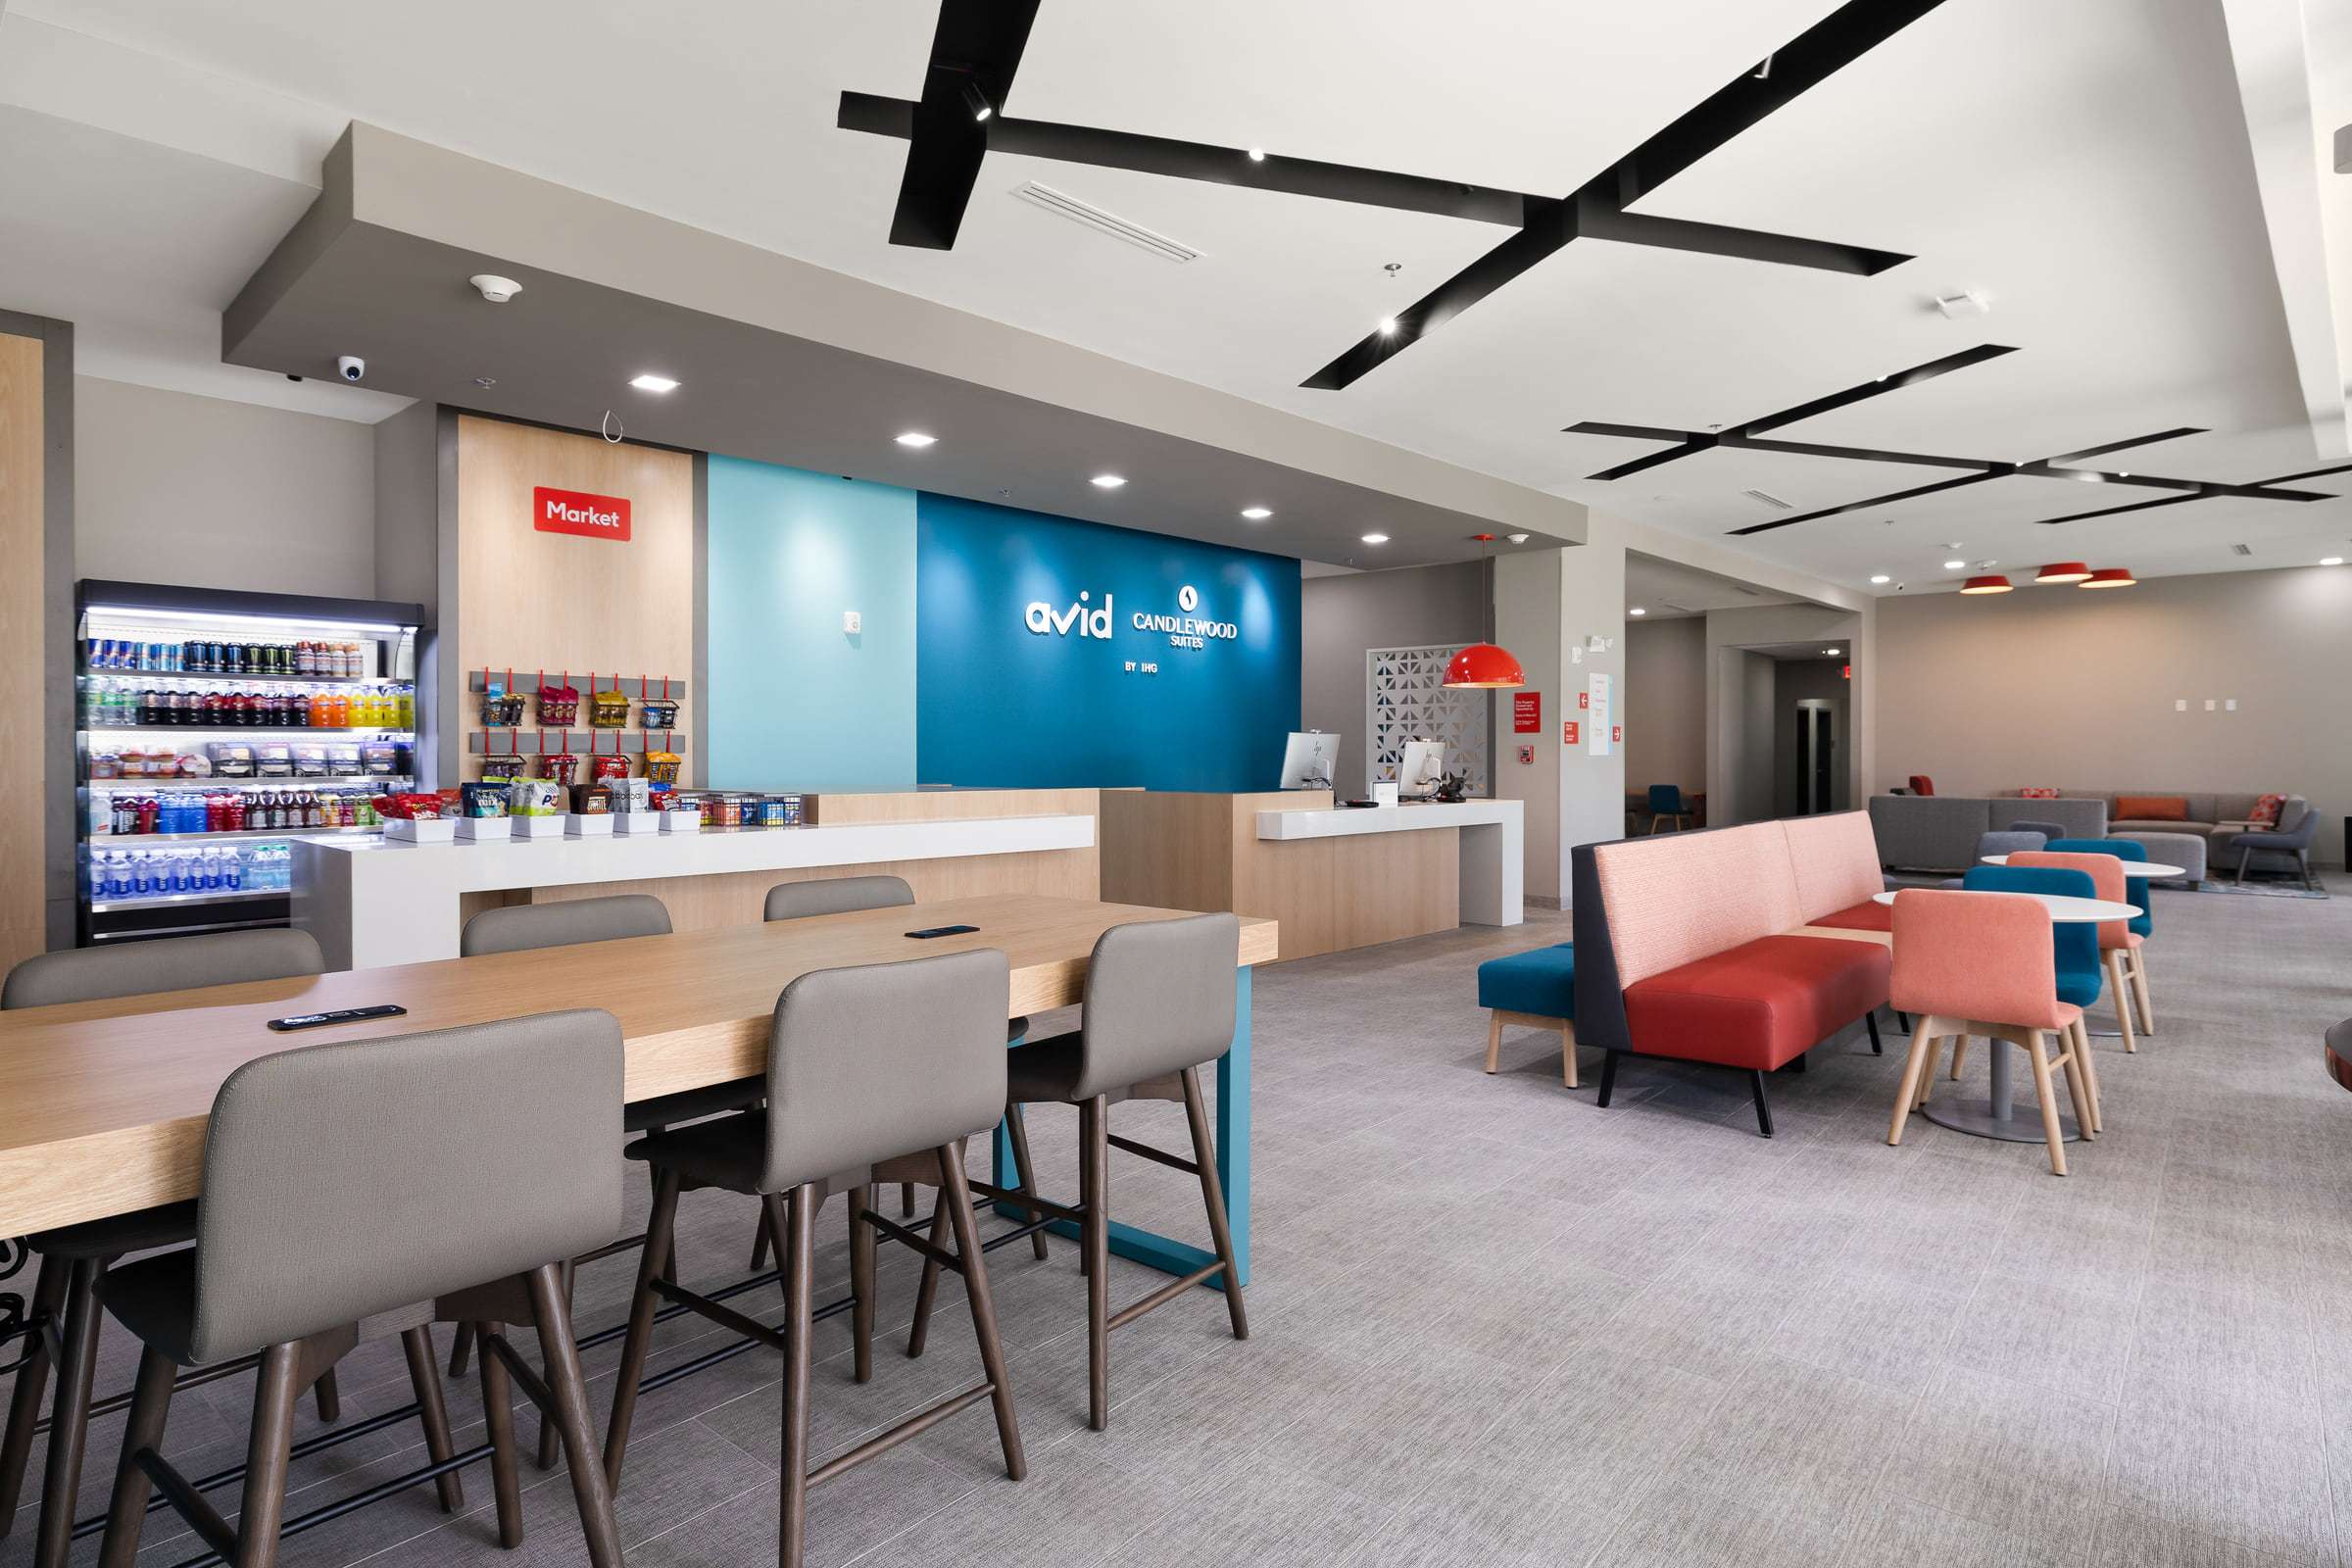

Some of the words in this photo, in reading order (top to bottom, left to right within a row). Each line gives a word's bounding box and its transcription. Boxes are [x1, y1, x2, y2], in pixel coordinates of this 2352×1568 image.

[547, 500, 619, 528] Market
[1025, 590, 1113, 639] avid
[1133, 612, 1238, 640] CANDLEWOOD
[1170, 635, 1204, 649] SUITES
[1125, 662, 1137, 672] BY
[1142, 662, 1158, 673] IHG
